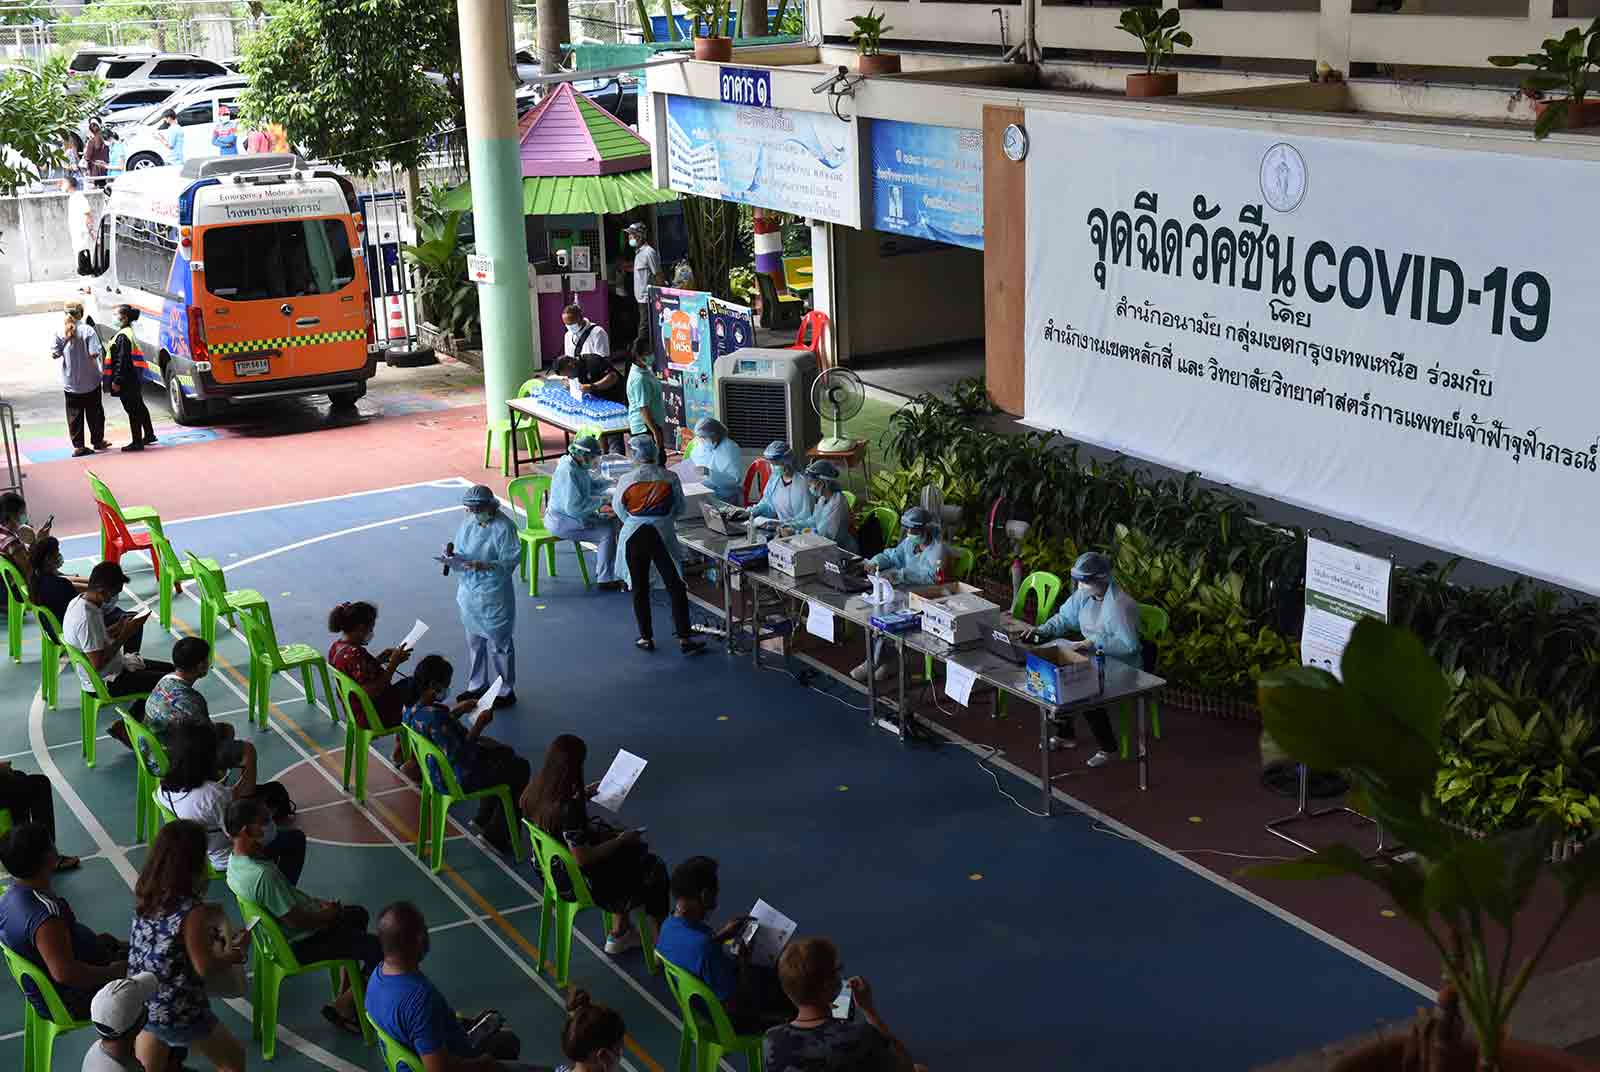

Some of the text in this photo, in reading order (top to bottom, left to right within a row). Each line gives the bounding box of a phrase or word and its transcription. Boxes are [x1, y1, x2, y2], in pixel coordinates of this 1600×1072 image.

[722, 73, 768, 107] อาคาร ๑
[219, 191, 263, 201] Emergency
[1087, 190, 1552, 342] จุดฉีดวัคซีน COVID-19
[1268, 298, 1311, 328] โดย
[1043, 318, 1173, 370] สำนักงานเขตหลักสี่
[1177, 356, 1205, 377] และ
[1115, 295, 1493, 398] สำนักอนามัย กลุ่มเขตกรุงเทพเหนือ ร่วมกับ
